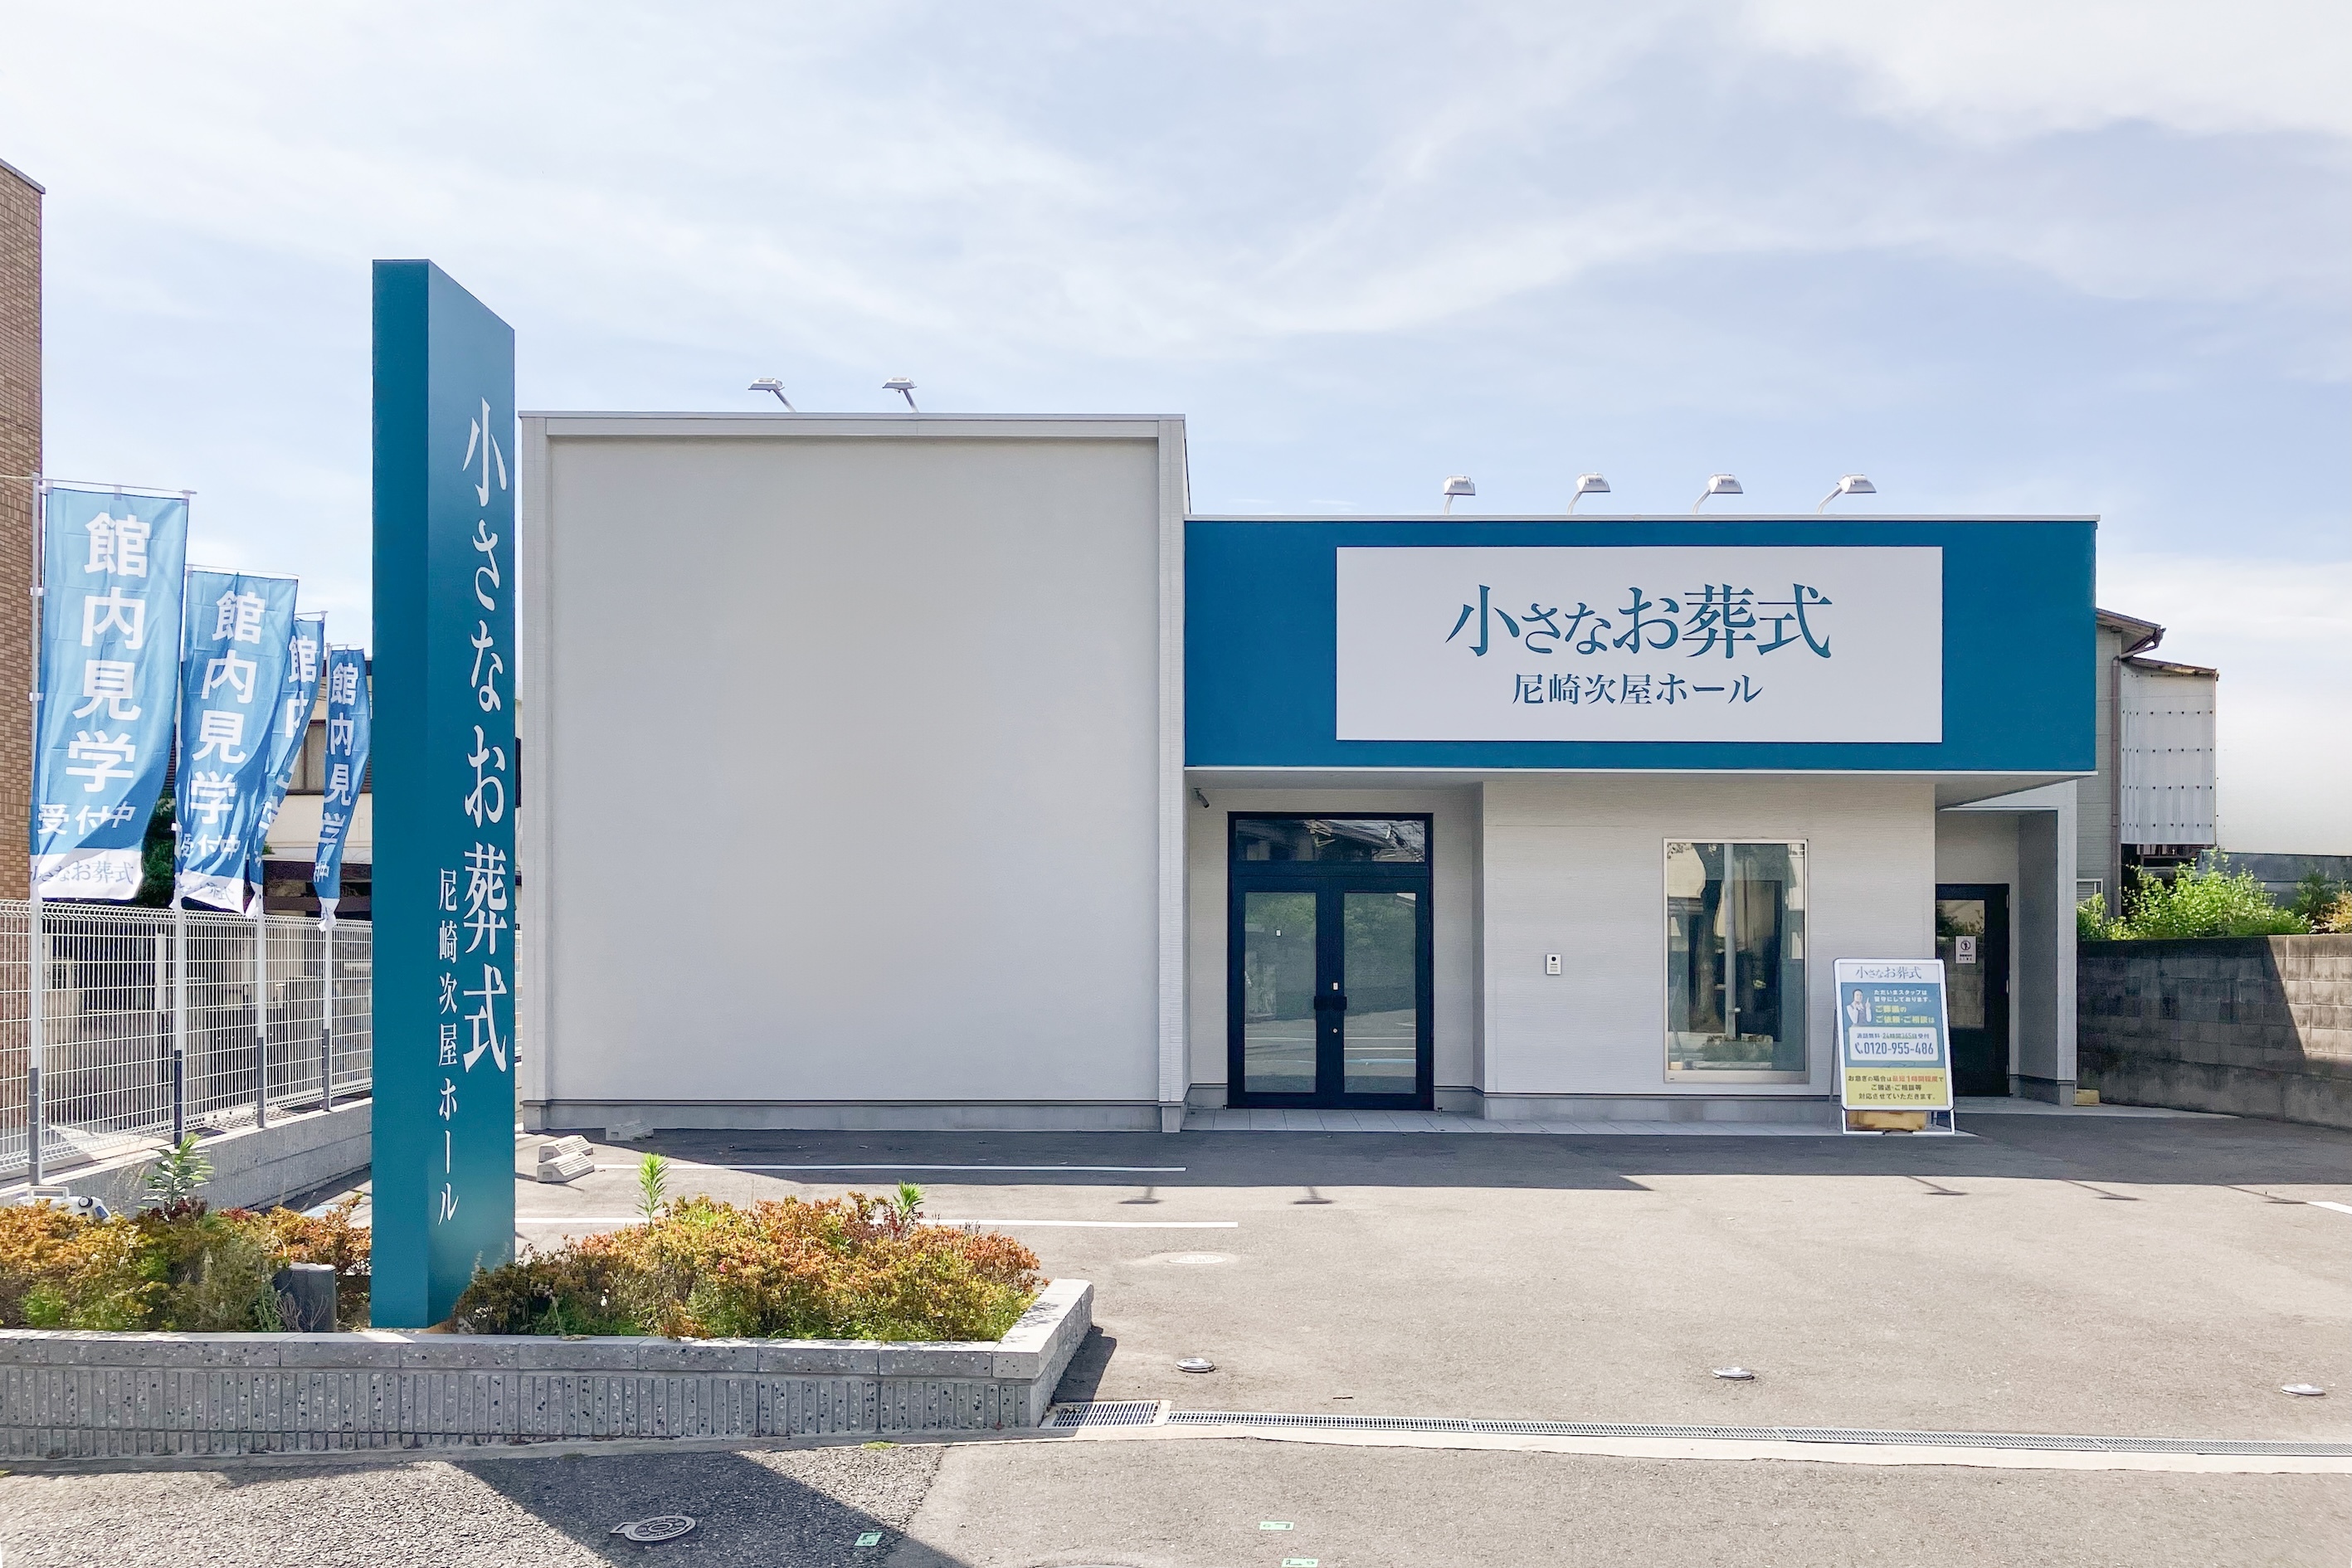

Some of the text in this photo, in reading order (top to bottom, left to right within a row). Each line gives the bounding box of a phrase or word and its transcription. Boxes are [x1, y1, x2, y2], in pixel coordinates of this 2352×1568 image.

[66, 511, 151, 793] 館内見学
[1445, 584, 1833, 660] 小さなお葬式
[190, 590, 266, 825] 館内見学
[462, 397, 509, 1073] 小さなお葬式
[1512, 673, 1765, 705] 尼崎次屋ホール
[319, 663, 360, 844] 館内見学
[37, 801, 136, 835] 受付中
[1855, 965, 1922, 980] 小さなお葬式
[437, 867, 460, 1226] 尼崎次屋ホール
[1863, 1041, 1934, 1055] 0120-955-486
